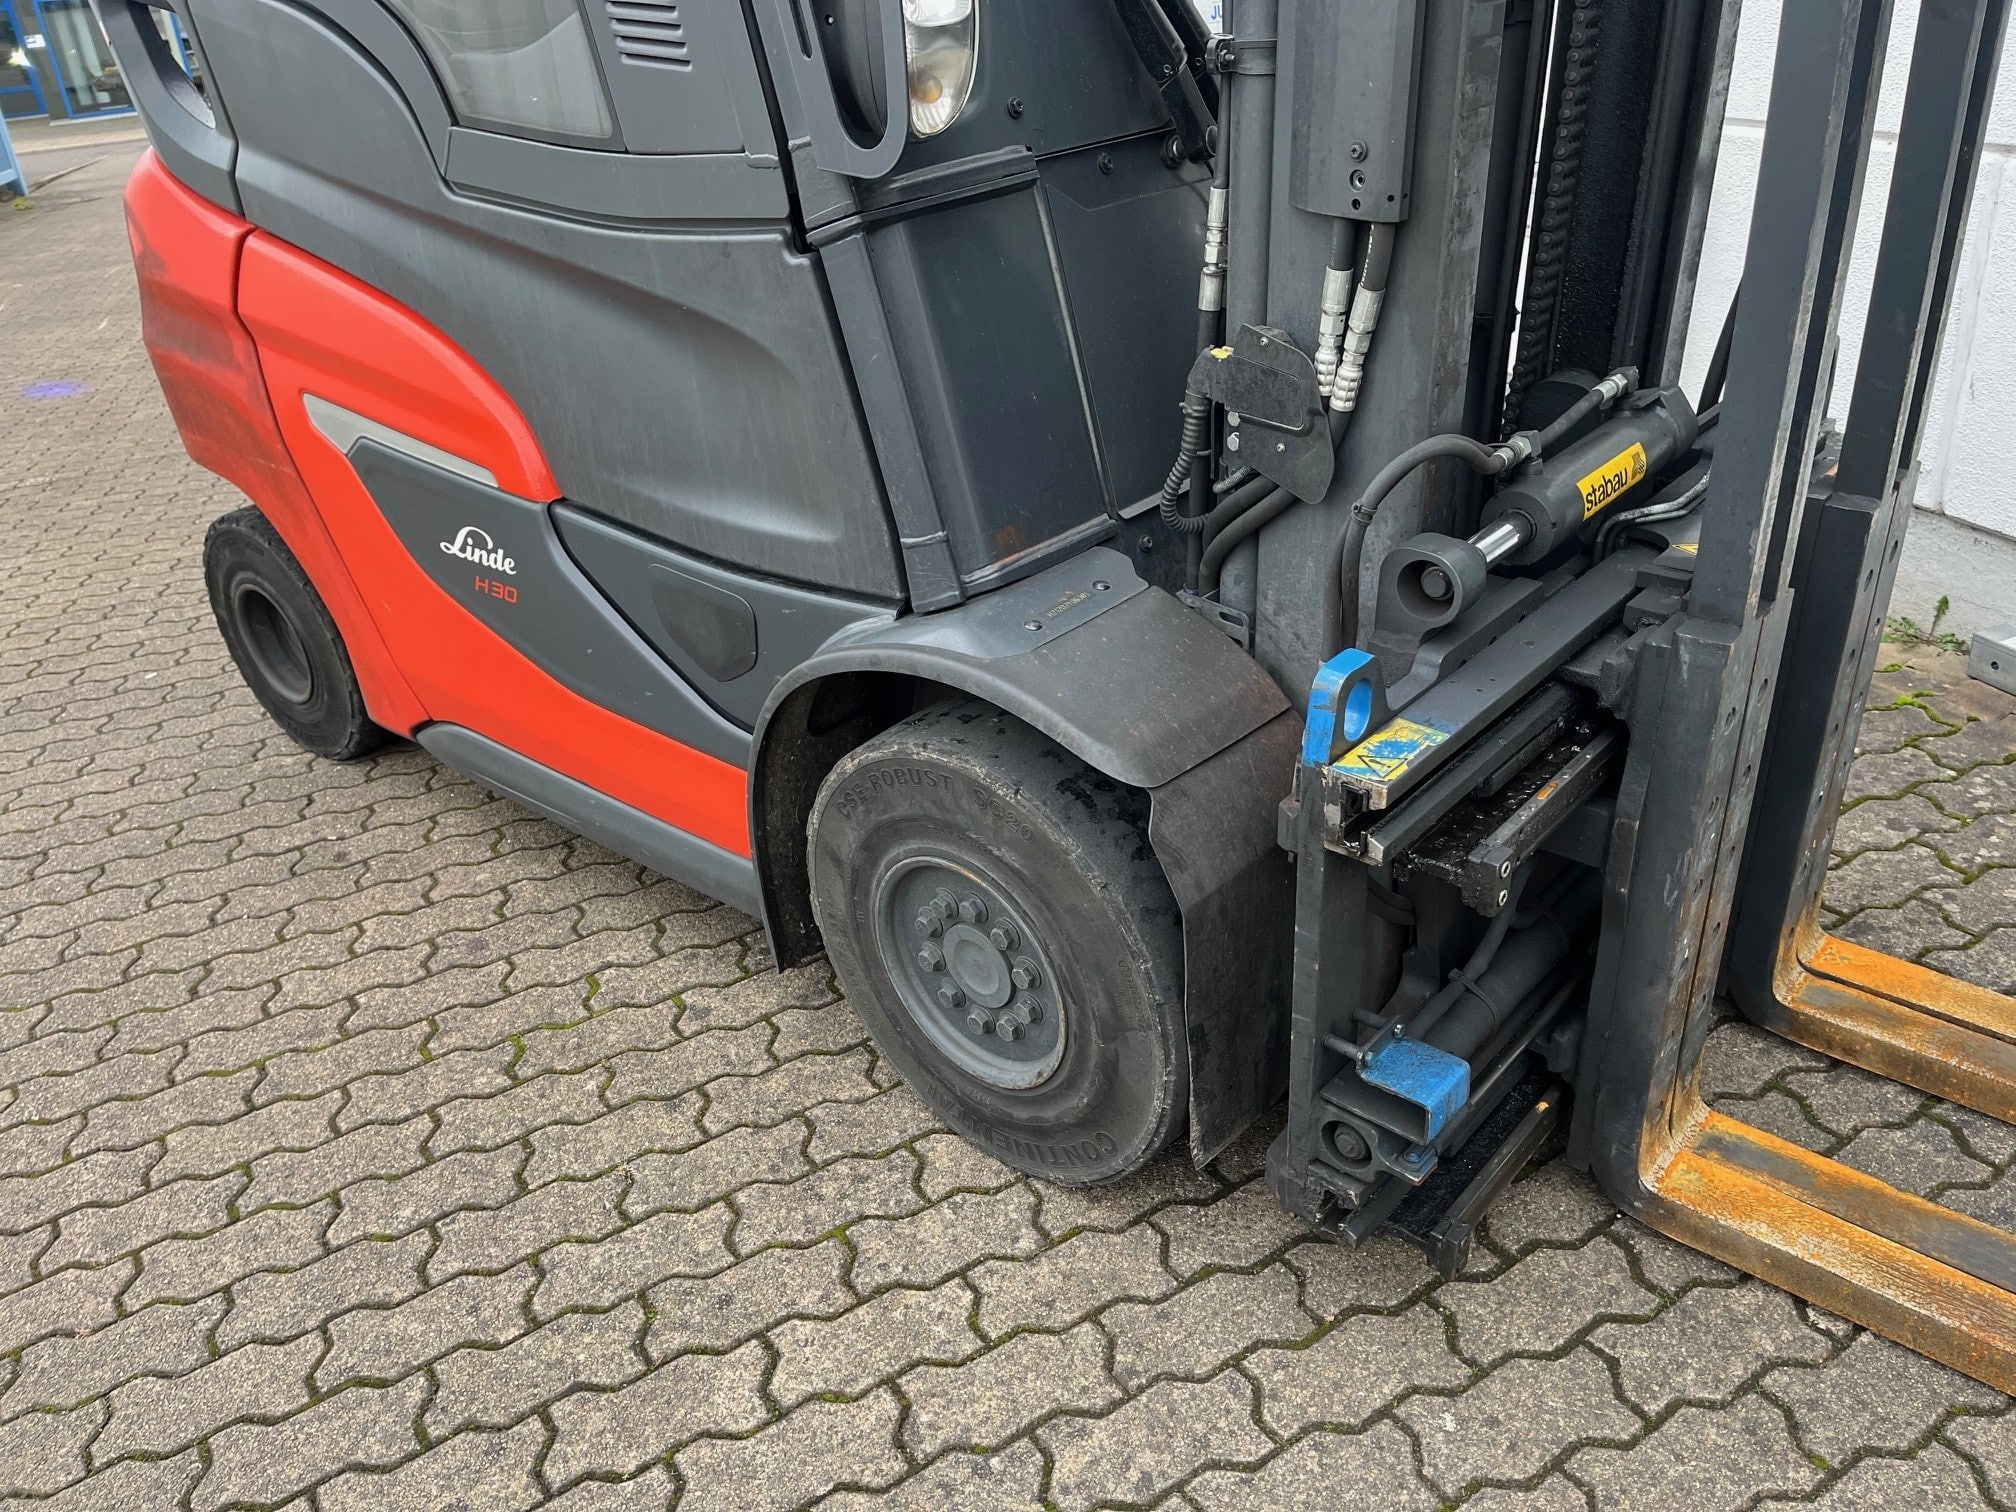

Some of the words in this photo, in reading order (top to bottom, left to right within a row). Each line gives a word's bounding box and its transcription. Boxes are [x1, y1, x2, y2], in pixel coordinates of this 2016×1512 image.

[1585, 467, 1628, 512] stabau
[439, 526, 517, 575] Linde
[474, 575, 489, 594] H
[491, 580, 518, 604] 30
